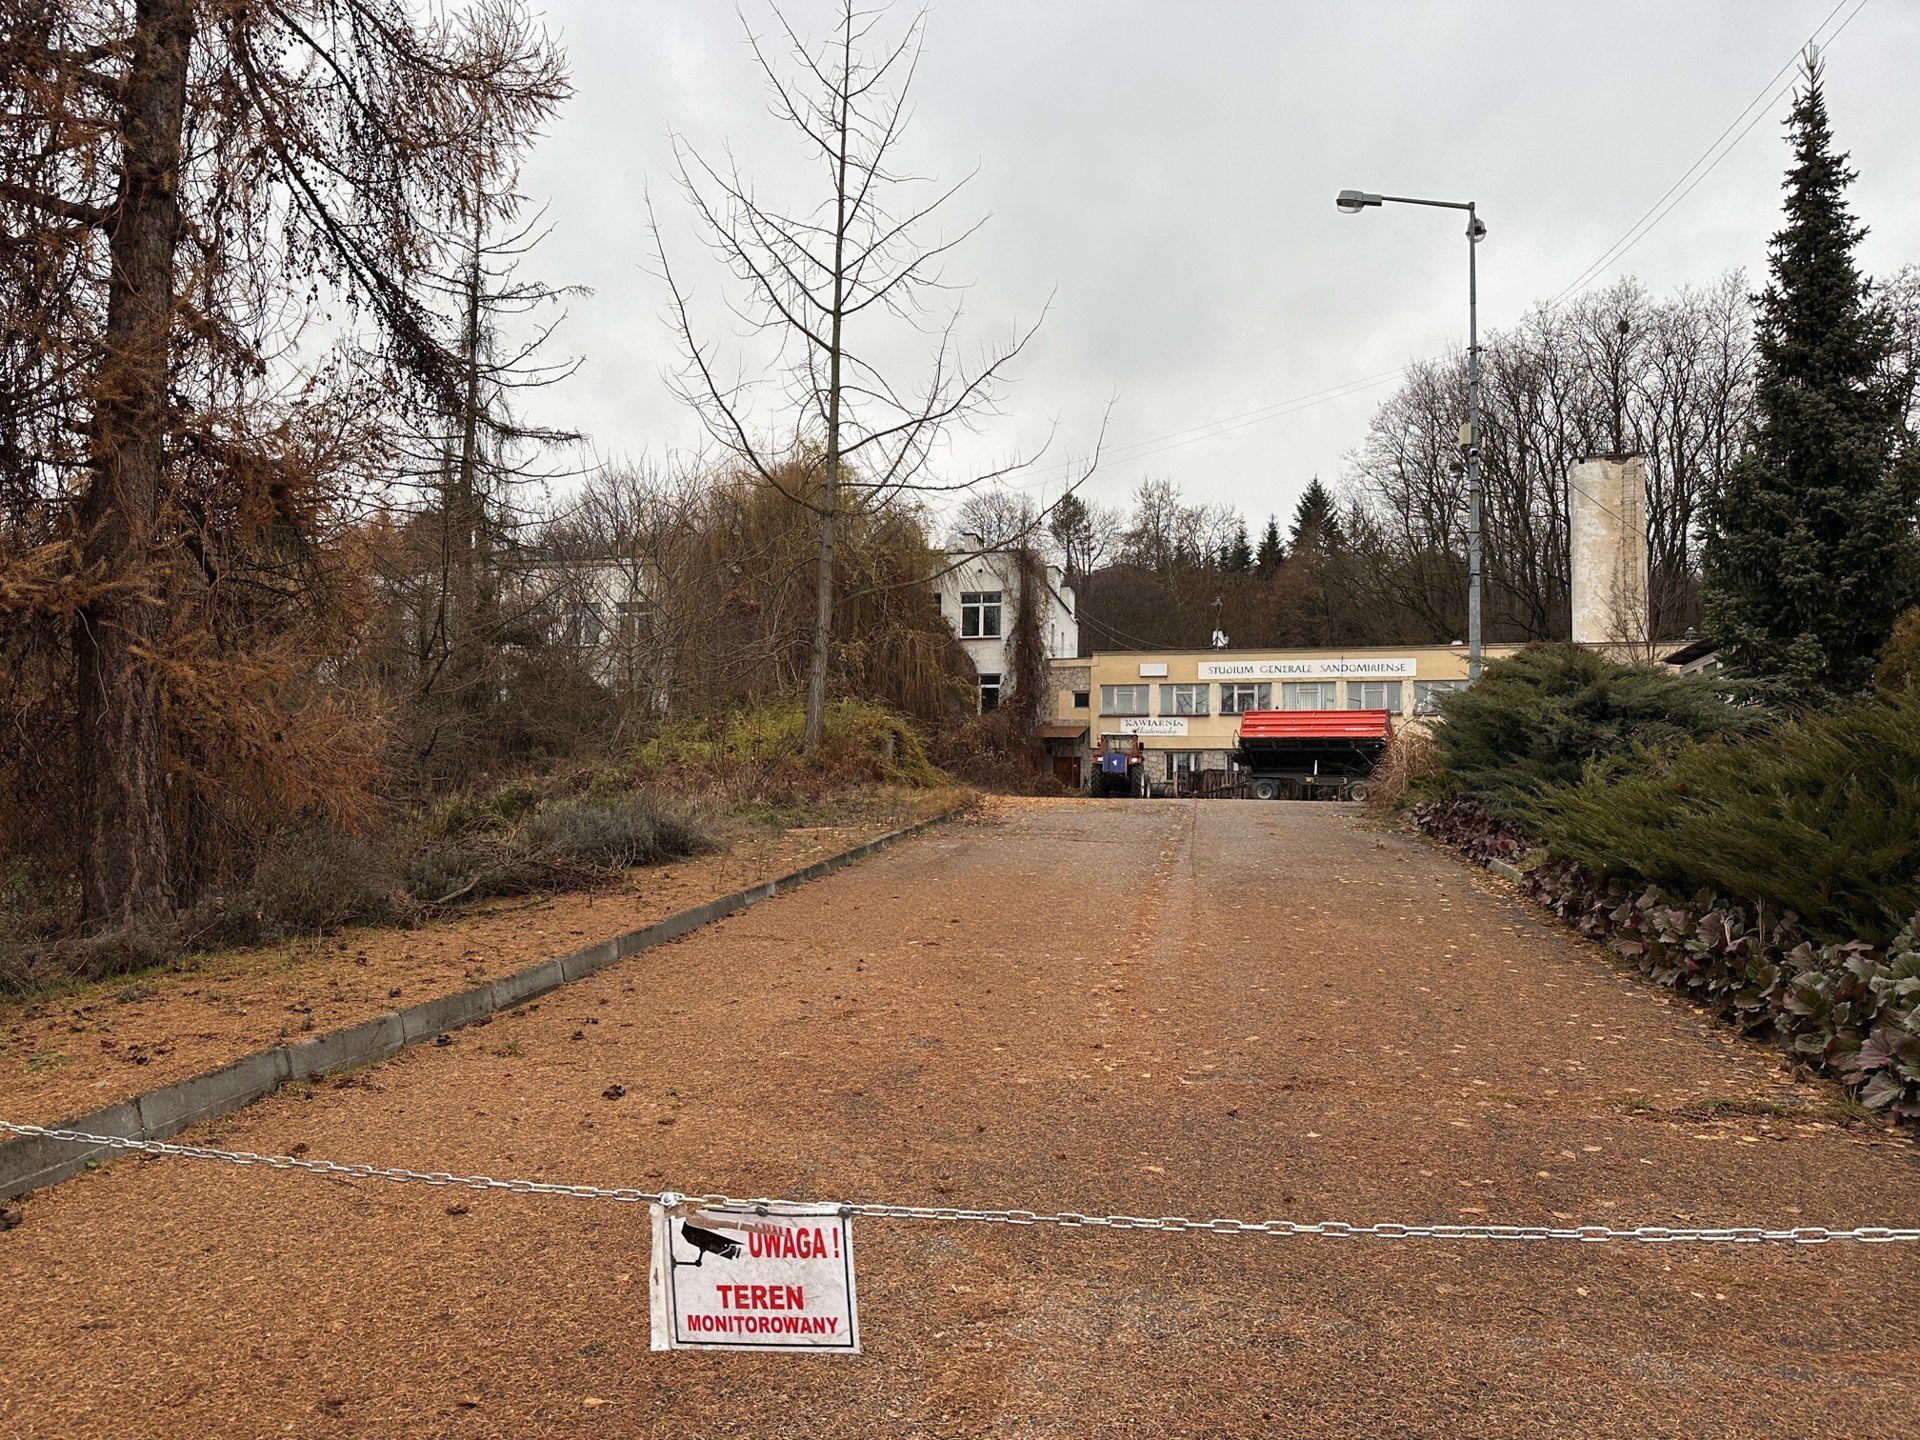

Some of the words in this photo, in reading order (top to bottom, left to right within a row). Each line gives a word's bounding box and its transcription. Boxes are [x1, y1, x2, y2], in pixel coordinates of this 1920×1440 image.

[1208, 666, 1254, 674] STUDIUM
[1259, 665, 1313, 674] GENERALE
[1320, 663, 1406, 672] SANDOMIRIENSE
[749, 1224, 828, 1259] UWAGA
[716, 1285, 804, 1310] TEREN
[687, 1315, 839, 1334] MONITOROWANY
